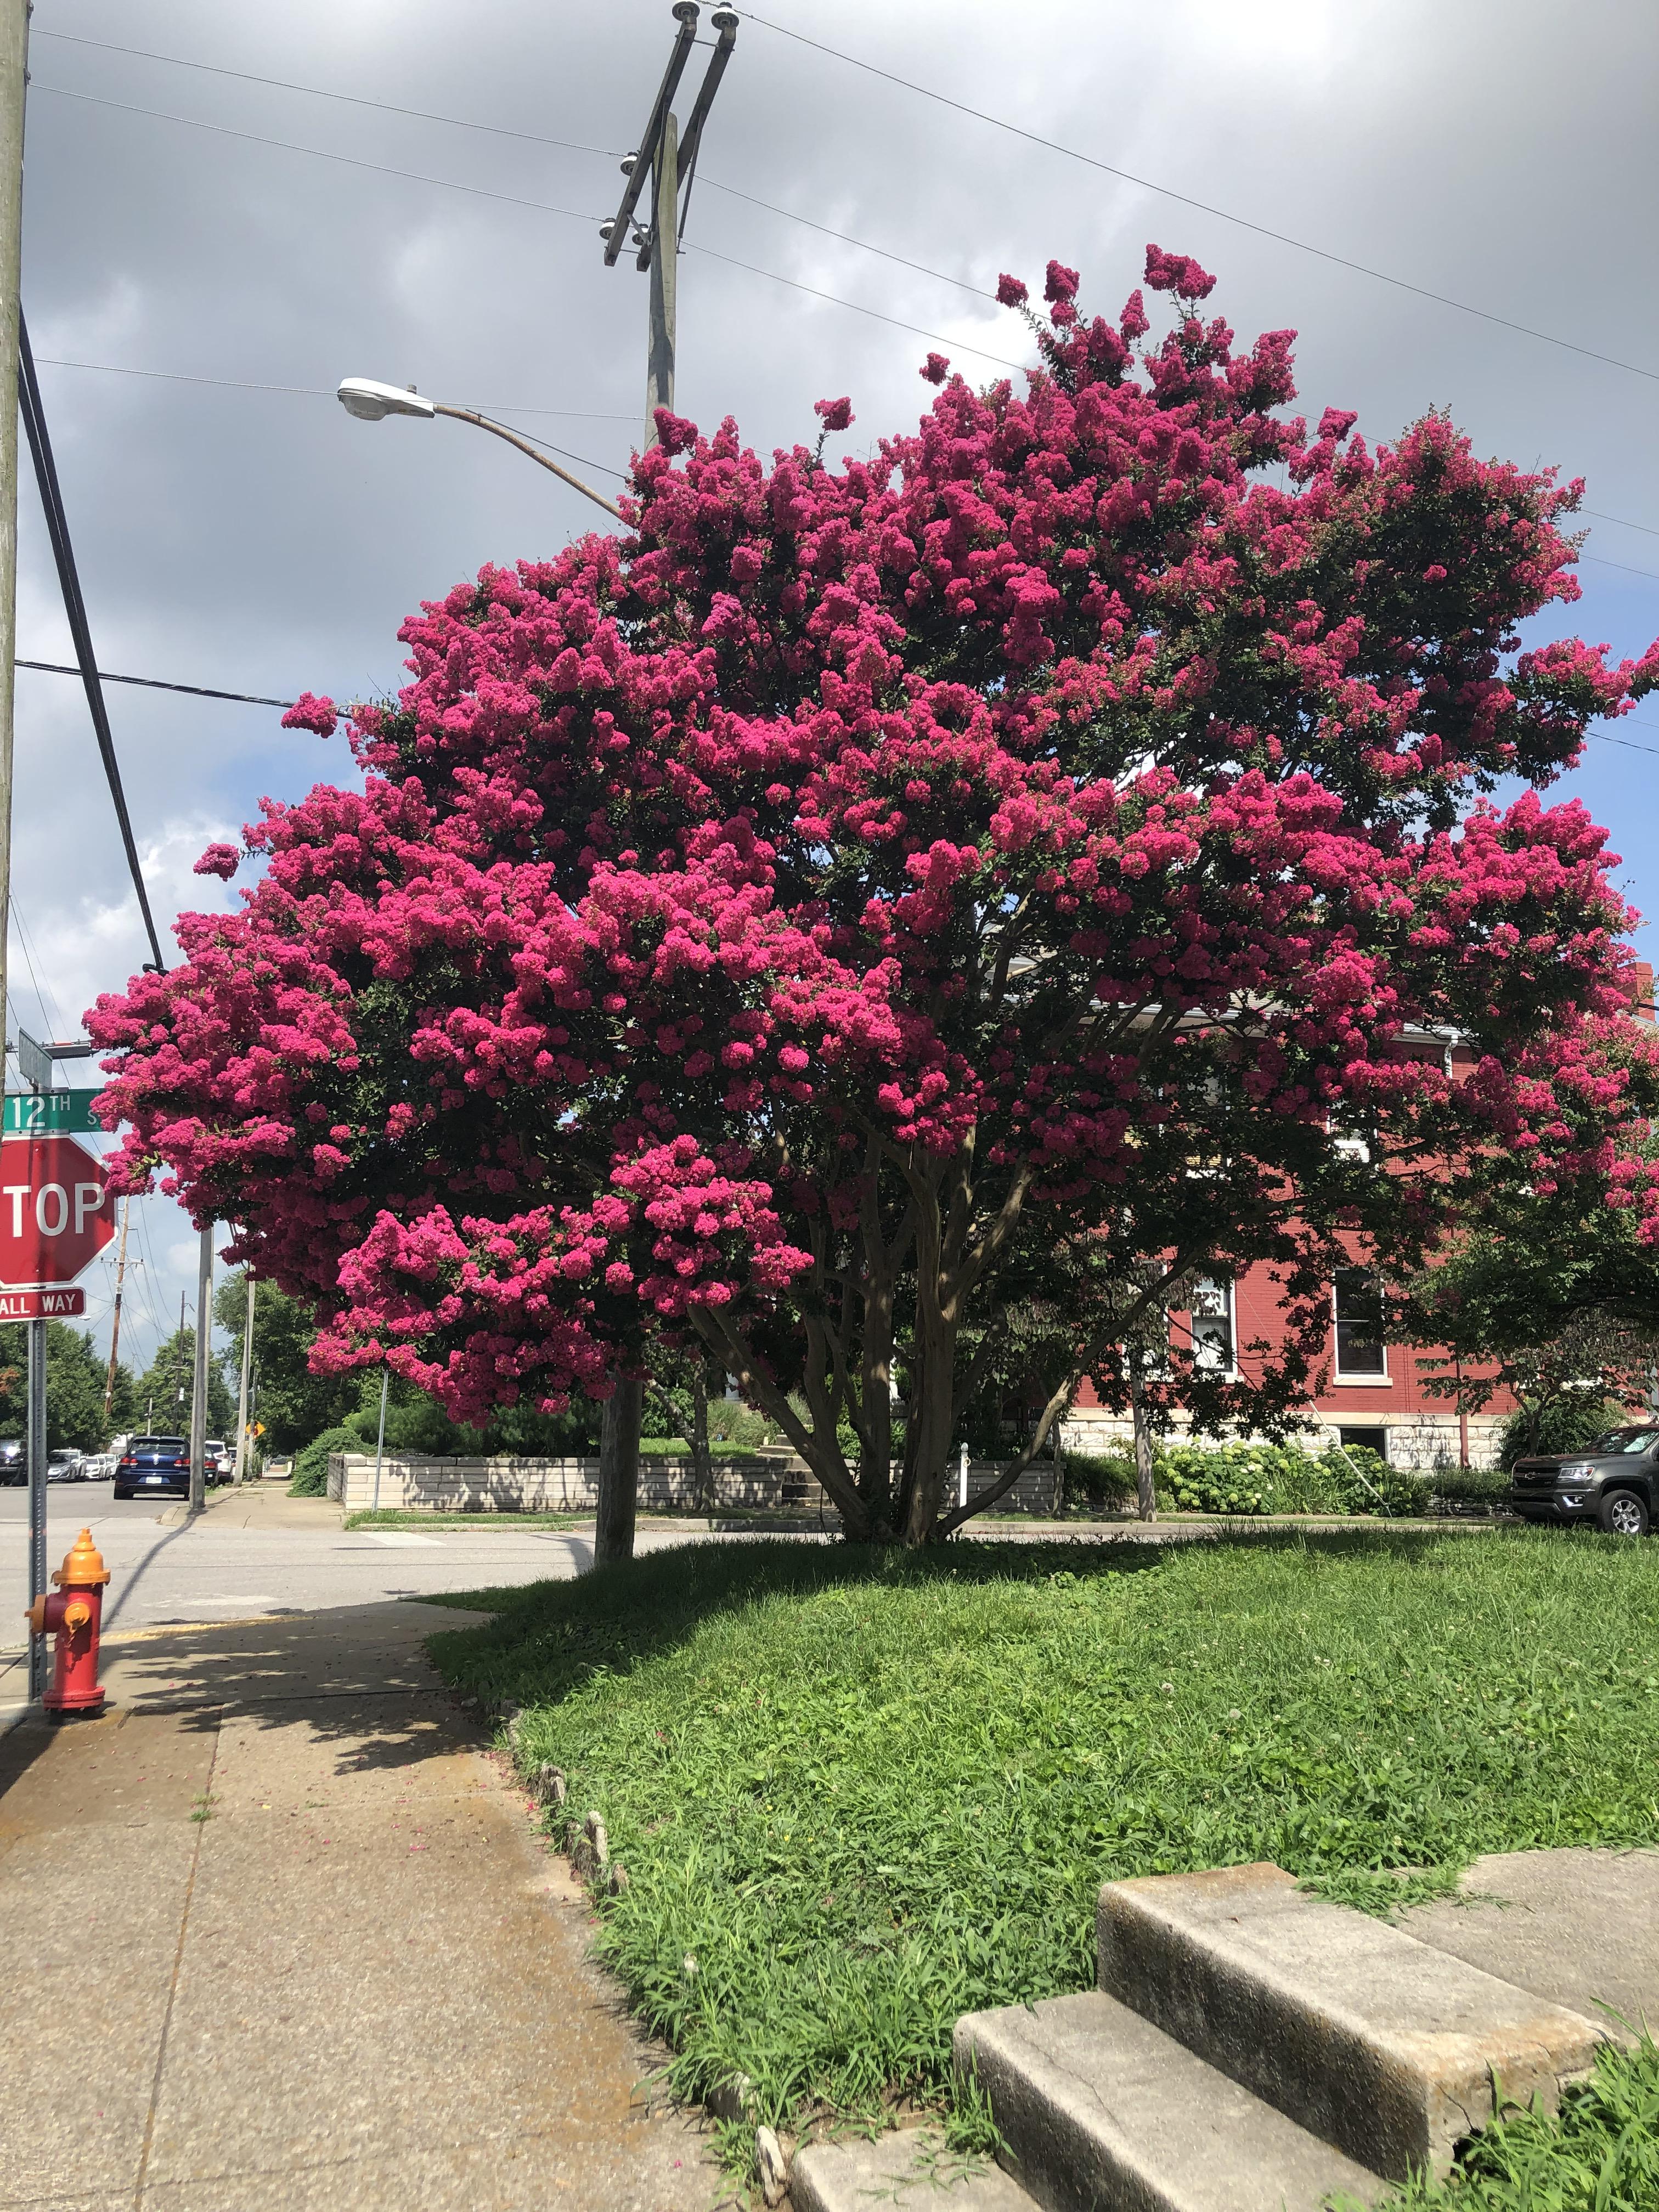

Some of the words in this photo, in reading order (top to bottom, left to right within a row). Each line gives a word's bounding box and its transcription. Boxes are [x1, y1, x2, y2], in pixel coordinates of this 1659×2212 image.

[13, 1095, 71, 1128] 12TH
[87, 1109, 98, 1125] S
[0, 1297, 31, 1314] ALL
[42, 1294, 76, 1312] WAY
